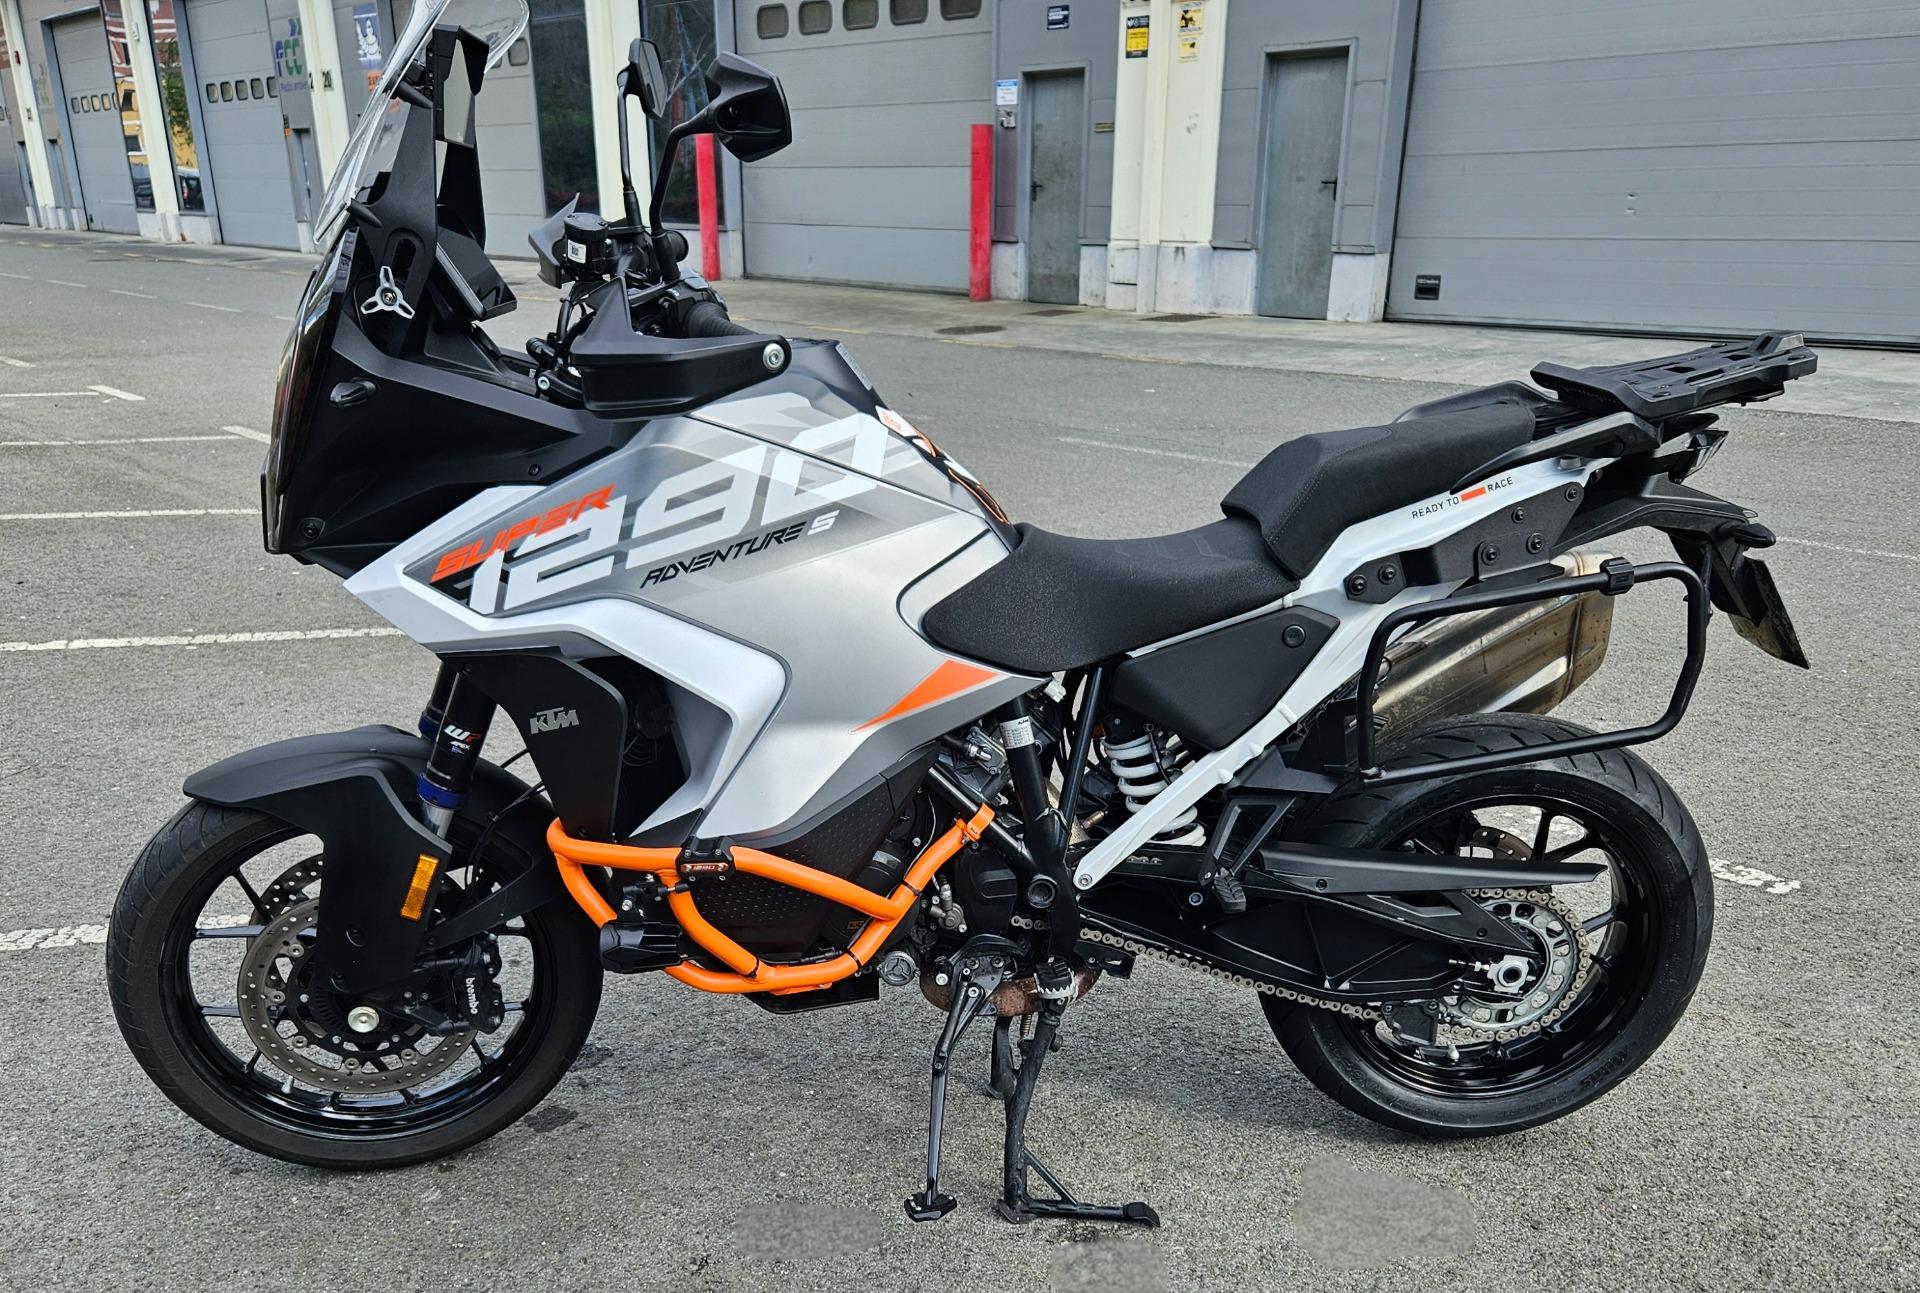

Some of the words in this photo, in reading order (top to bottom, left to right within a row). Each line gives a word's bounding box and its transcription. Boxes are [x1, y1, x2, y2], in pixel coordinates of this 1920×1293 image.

[469, 412, 888, 616] 1290
[1412, 501, 1444, 519] READY
[1447, 496, 1460, 507] TO
[1487, 476, 1513, 492] RACE
[430, 483, 617, 583] SUPER
[640, 521, 807, 589] ADVENTURE
[807, 510, 840, 536] S
[530, 706, 580, 735] KTM
[466, 977, 479, 1014] brembo
